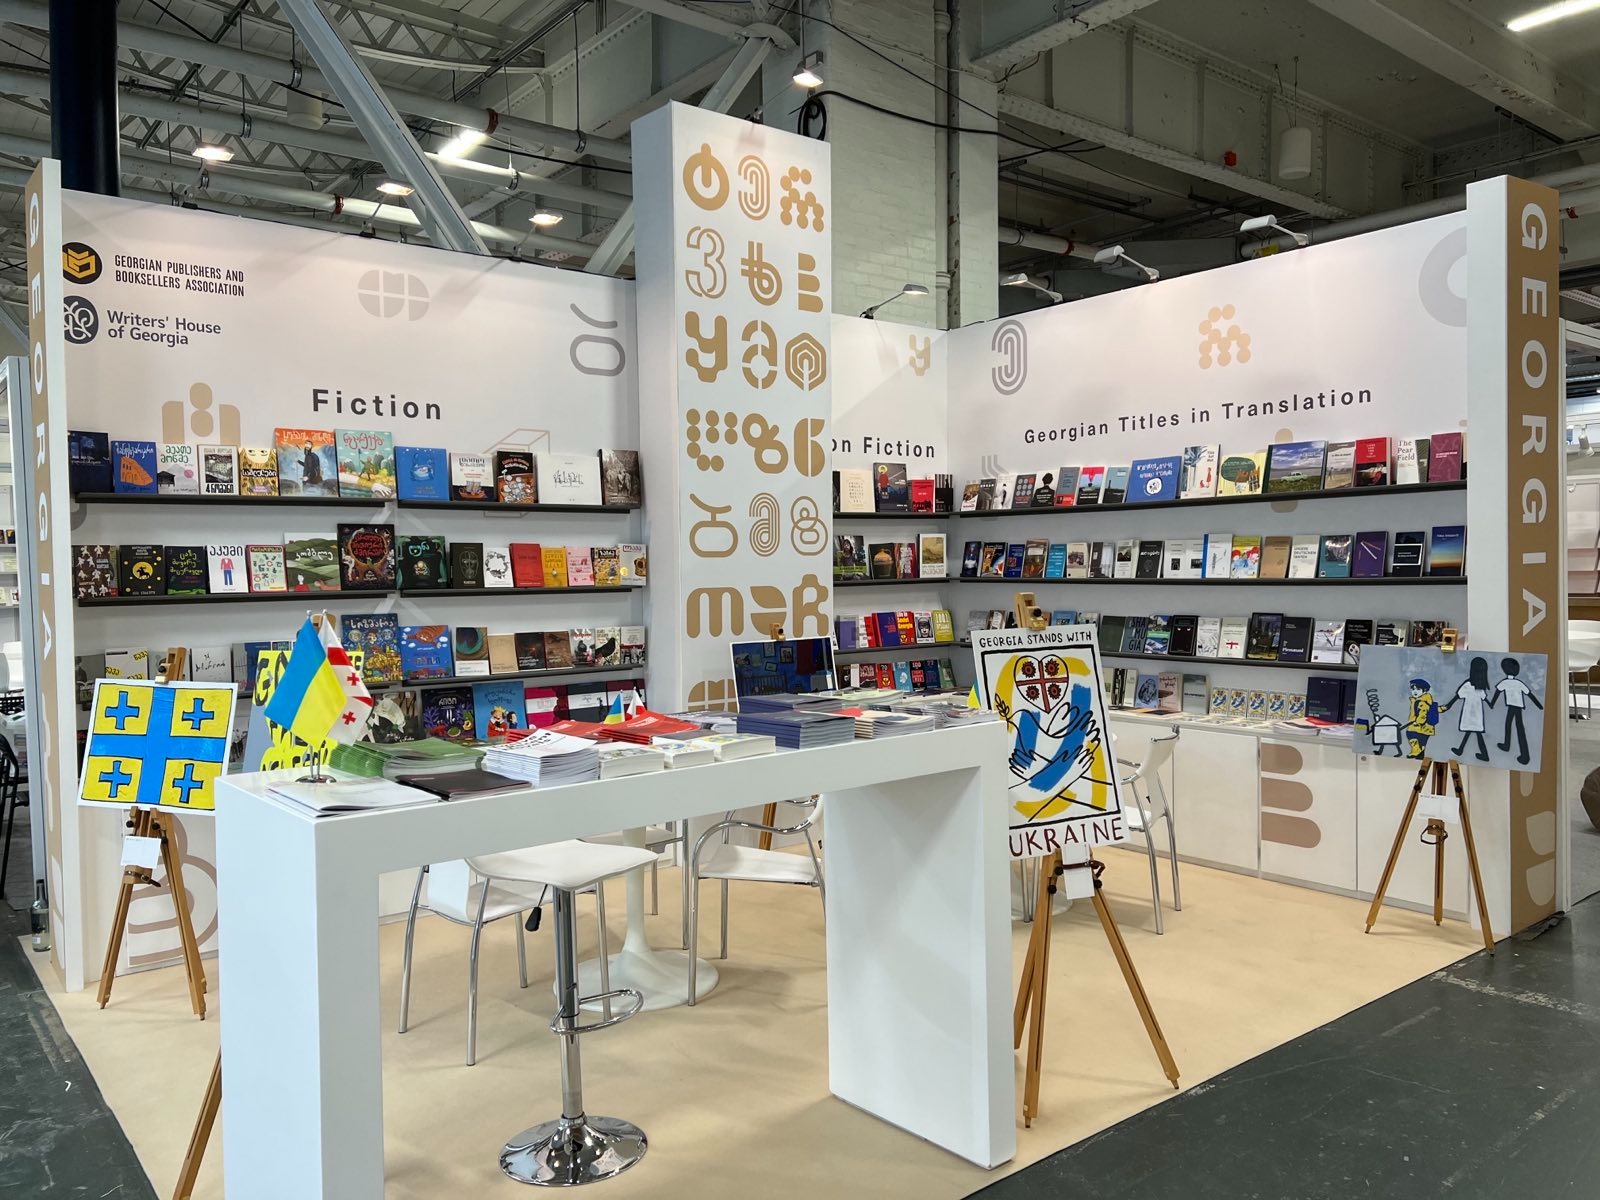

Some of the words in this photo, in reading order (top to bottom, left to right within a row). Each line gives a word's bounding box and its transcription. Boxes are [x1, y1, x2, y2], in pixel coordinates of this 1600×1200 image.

[115, 254, 162, 272] GEORGIAN
[167, 261, 222, 280] PUBLISHERS
[225, 269, 244, 283] AND
[115, 270, 181, 289] BOOKSELLERS
[185, 280, 245, 297] ASSOCIATION
[107, 309, 169, 329] Writers'
[175, 317, 221, 334] House
[107, 326, 125, 339] of
[129, 329, 189, 348] Georgia
[313, 388, 441, 420] Fiction
[1024, 421, 1109, 444] Georgian
[1119, 412, 1180, 433] Titles
[1191, 407, 1210, 423] in
[1222, 388, 1372, 420] Translation
[29, 192, 52, 661] GEORGIA
[1521, 202, 1548, 638] GEORGIA
[863, 436, 935, 458] Fiction
[979, 635, 1024, 648] GEORGIA
[1027, 632, 1063, 645] STANDS
[1066, 630, 1092, 643] WITH
[1008, 817, 1125, 857] UKRAINE
